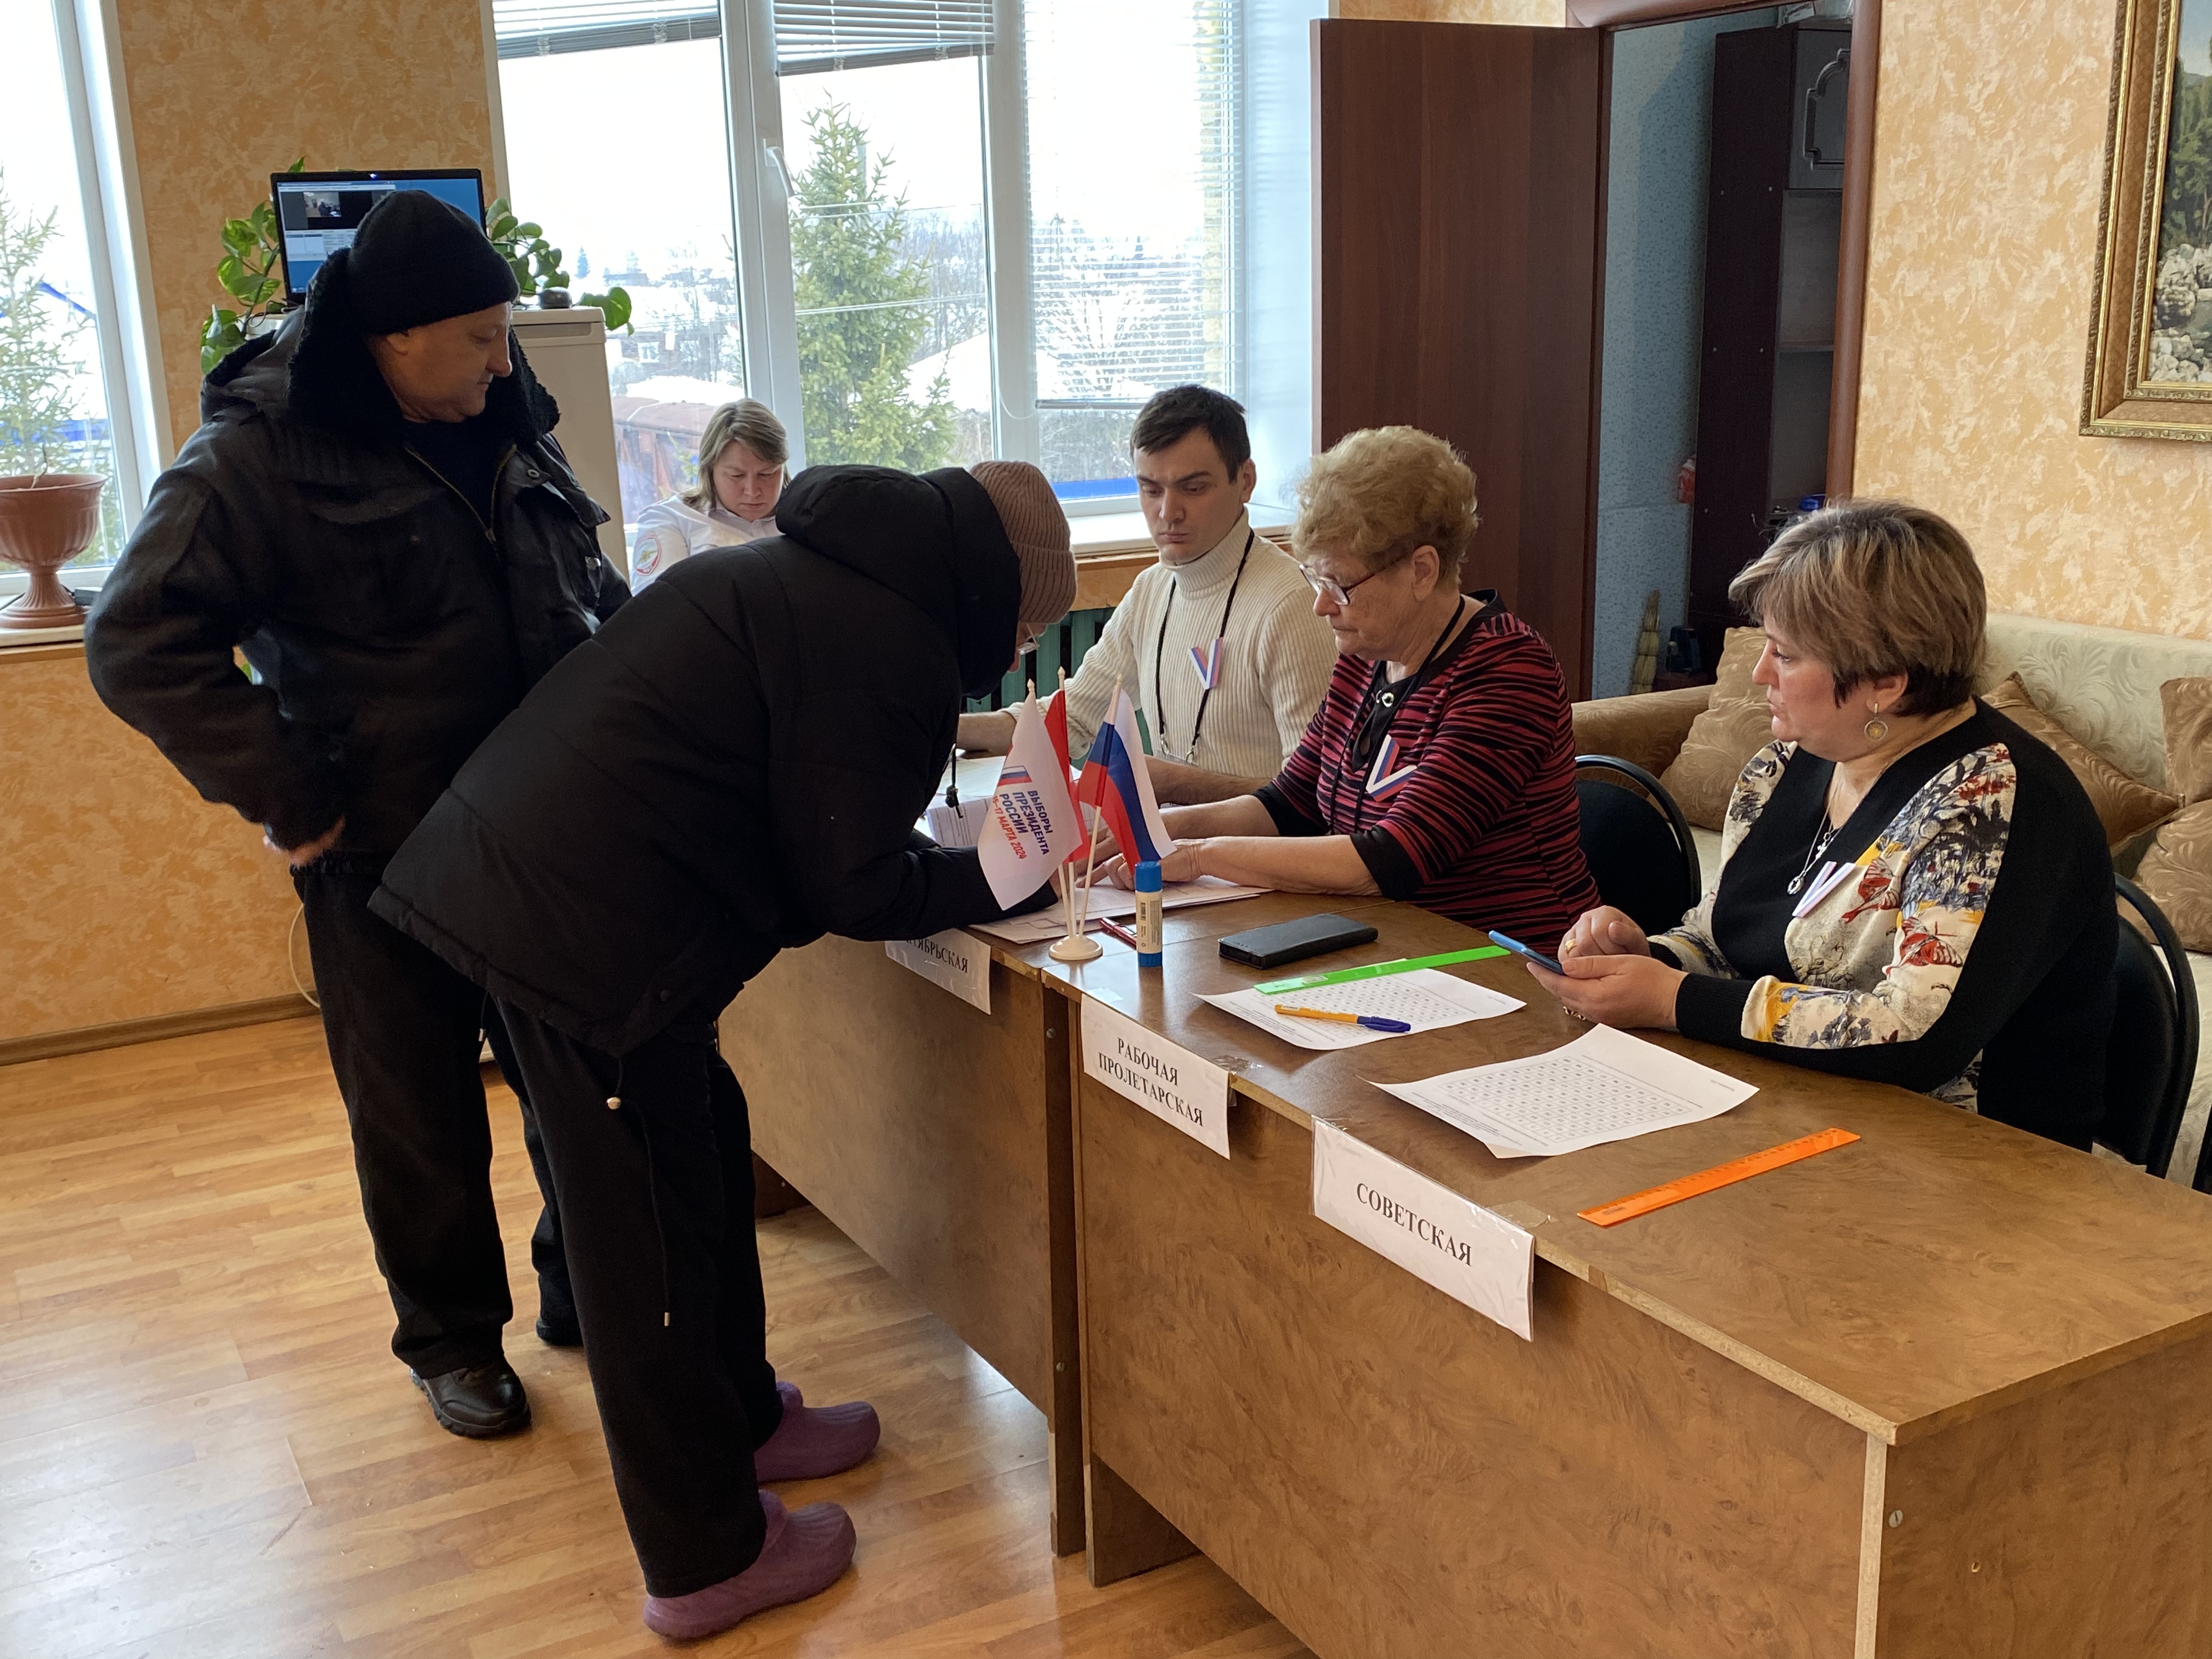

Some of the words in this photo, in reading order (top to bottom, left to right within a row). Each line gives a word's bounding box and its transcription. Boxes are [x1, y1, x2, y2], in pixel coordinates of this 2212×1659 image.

[999, 793, 1029, 833] РОССИИ
[1013, 792, 1049, 855] ПРЕЗИДЕНТА
[1028, 790, 1053, 833] ВЫБОРЫ
[997, 816, 1017, 841] МАРТА
[1011, 842, 1027, 859] 2024
[1117, 1037, 1178, 1086] РАБОЧАЯ
[1098, 1052, 1204, 1127] ПРОЛЕТАРСКАЯ
[1356, 1183, 1472, 1267] СОВЕТСКАЯ
